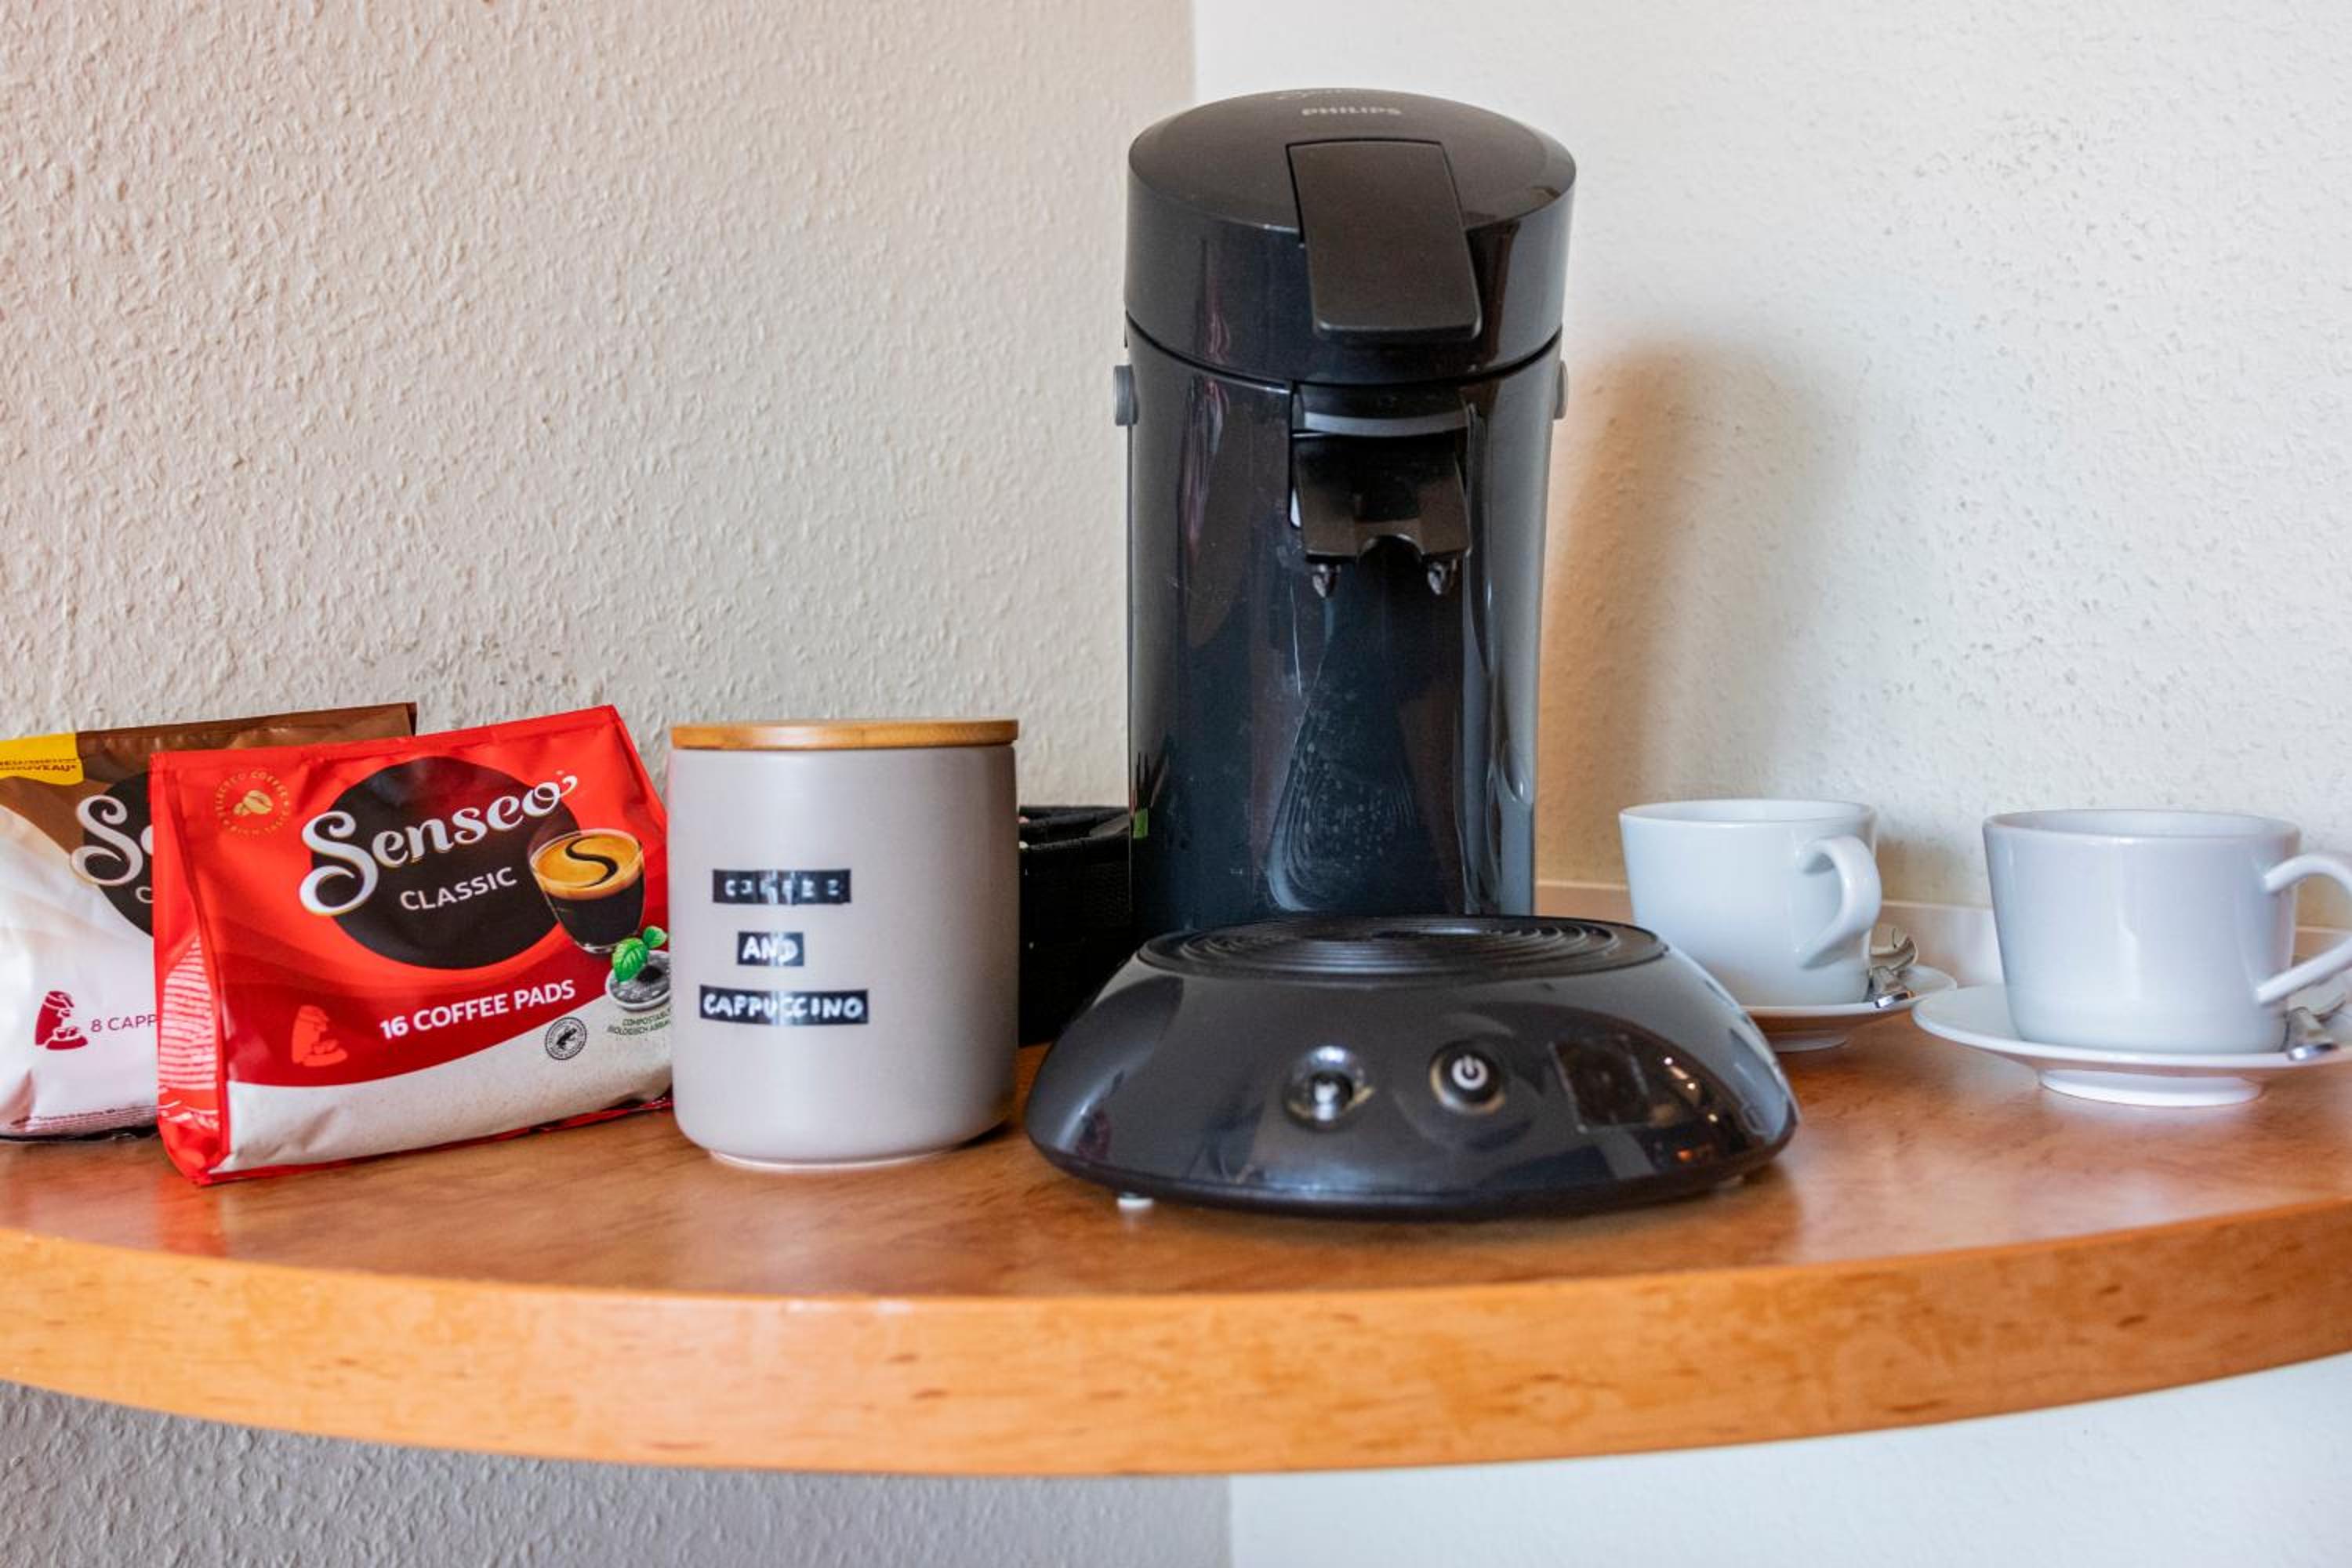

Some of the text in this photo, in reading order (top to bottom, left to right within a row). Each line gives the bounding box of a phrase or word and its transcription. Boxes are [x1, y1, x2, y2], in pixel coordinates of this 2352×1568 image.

[71, 794, 154, 887] S
[299, 774, 578, 916] Senseo
[399, 866, 517, 911] CLASSIC
[742, 935, 799, 964] AND
[90, 1018, 103, 1033] 8
[379, 978, 576, 1040] 16 COFFEE PADS
[702, 993, 863, 1019] CAPPUCCINO
